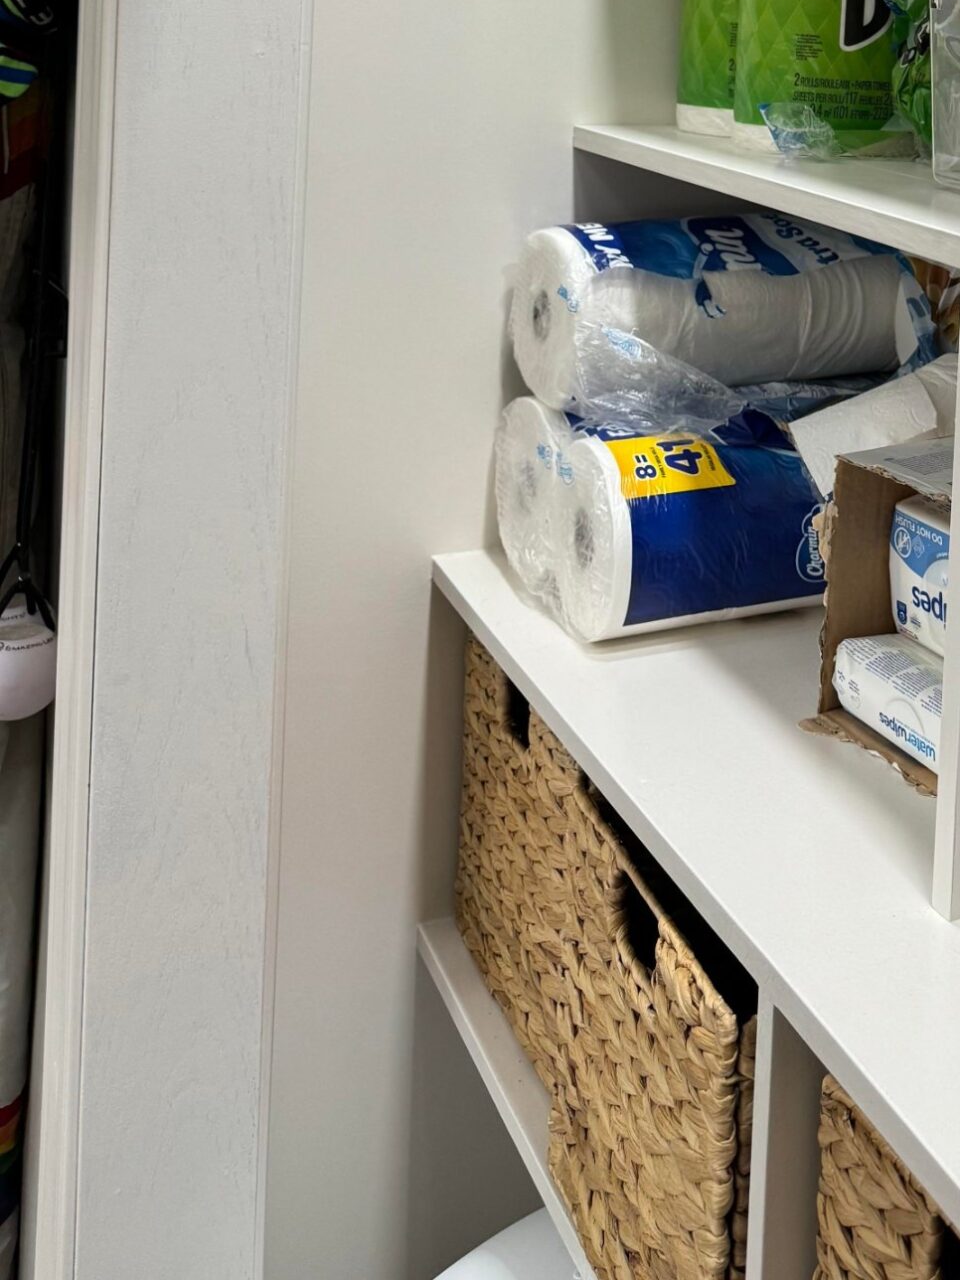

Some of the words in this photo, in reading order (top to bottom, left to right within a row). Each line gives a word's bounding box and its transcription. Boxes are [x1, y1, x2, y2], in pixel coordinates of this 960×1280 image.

[656, 438, 703, 476] 41
[916, 525, 932, 541] NOT
[931, 532, 943, 547] DO
[806, 525, 824, 577] Charmin
